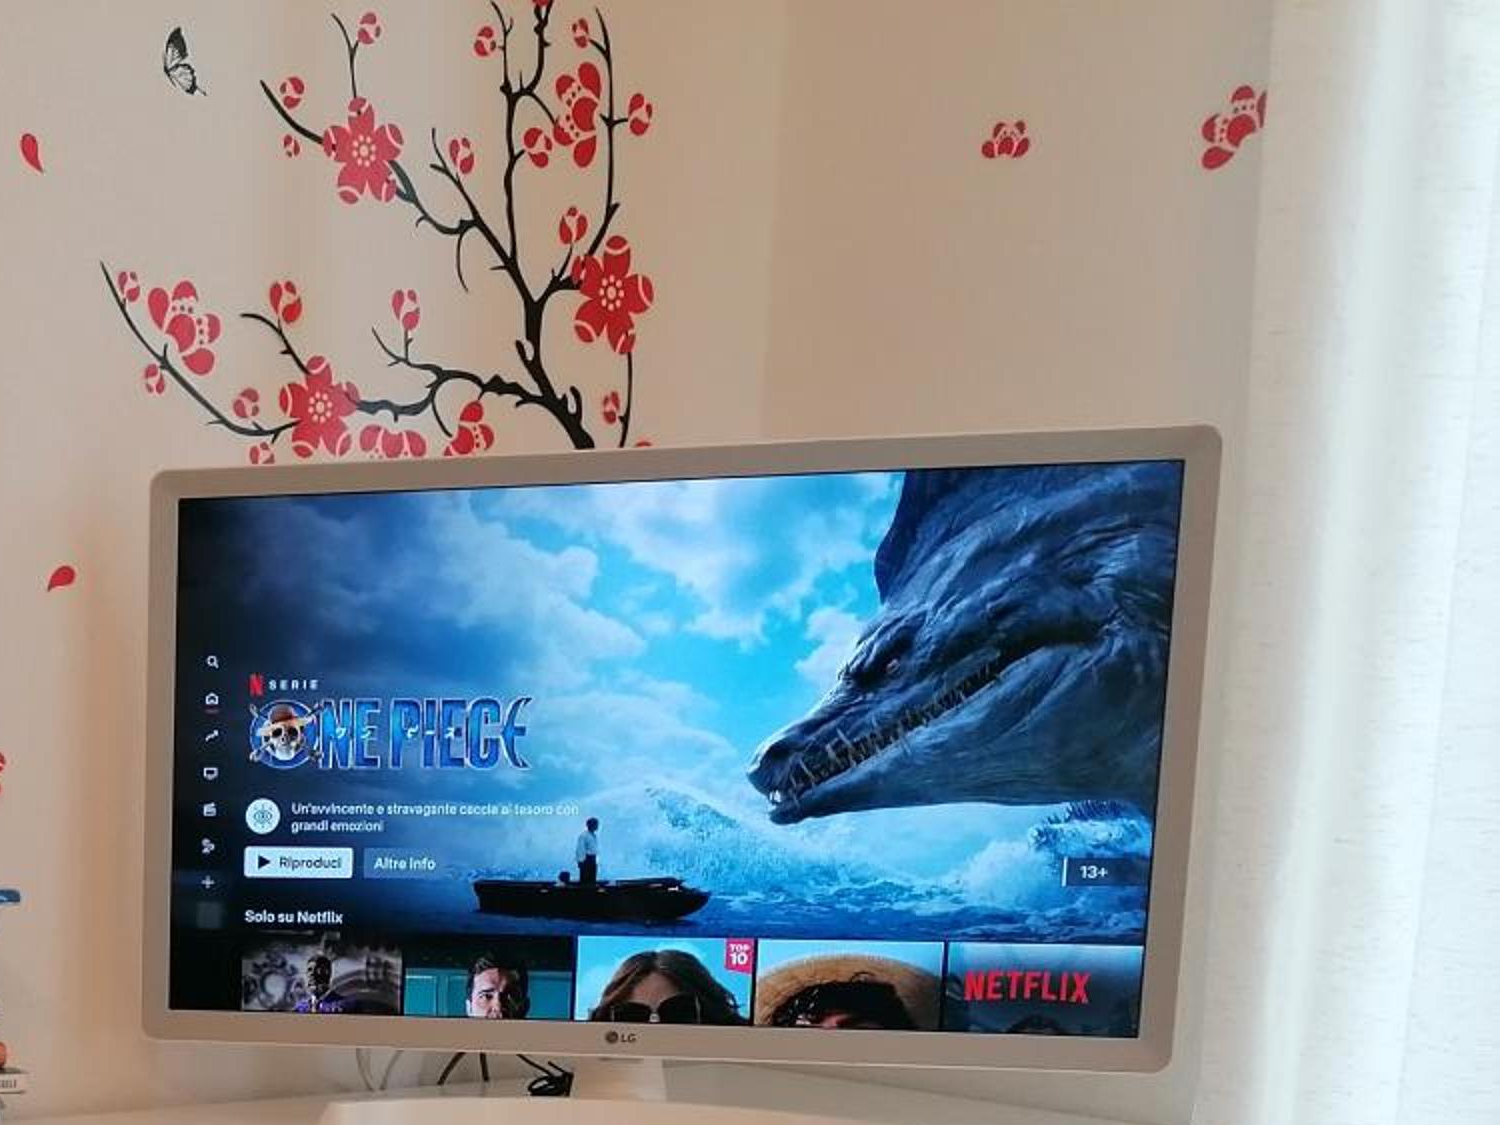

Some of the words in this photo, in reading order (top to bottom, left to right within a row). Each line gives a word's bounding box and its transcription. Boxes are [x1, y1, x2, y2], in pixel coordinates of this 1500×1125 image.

[269, 679, 319, 691] SERIE
[251, 698, 381, 769] ONE
[389, 696, 532, 770] PIECE
[292, 803, 374, 816] Un'avvincente
[377, 806, 385, 815] e
[387, 804, 457, 818] stravagante
[459, 804, 498, 816] caccia
[513, 804, 553, 816] tesoro
[556, 806, 579, 816] con
[291, 820, 327, 833] grandi
[329, 820, 384, 832] emozioni
[279, 856, 342, 871] Riproduci
[373, 857, 407, 870] Altre
[409, 857, 437, 871] info
[1079, 865, 1109, 880] 13+
[244, 911, 275, 924] Solo
[277, 913, 294, 924] su
[297, 910, 344, 924] Netflix
[728, 943, 750, 953] TOP
[730, 952, 749, 966] 10
[964, 970, 1092, 1003] NETFLIX
[621, 1032, 636, 1043] LG
